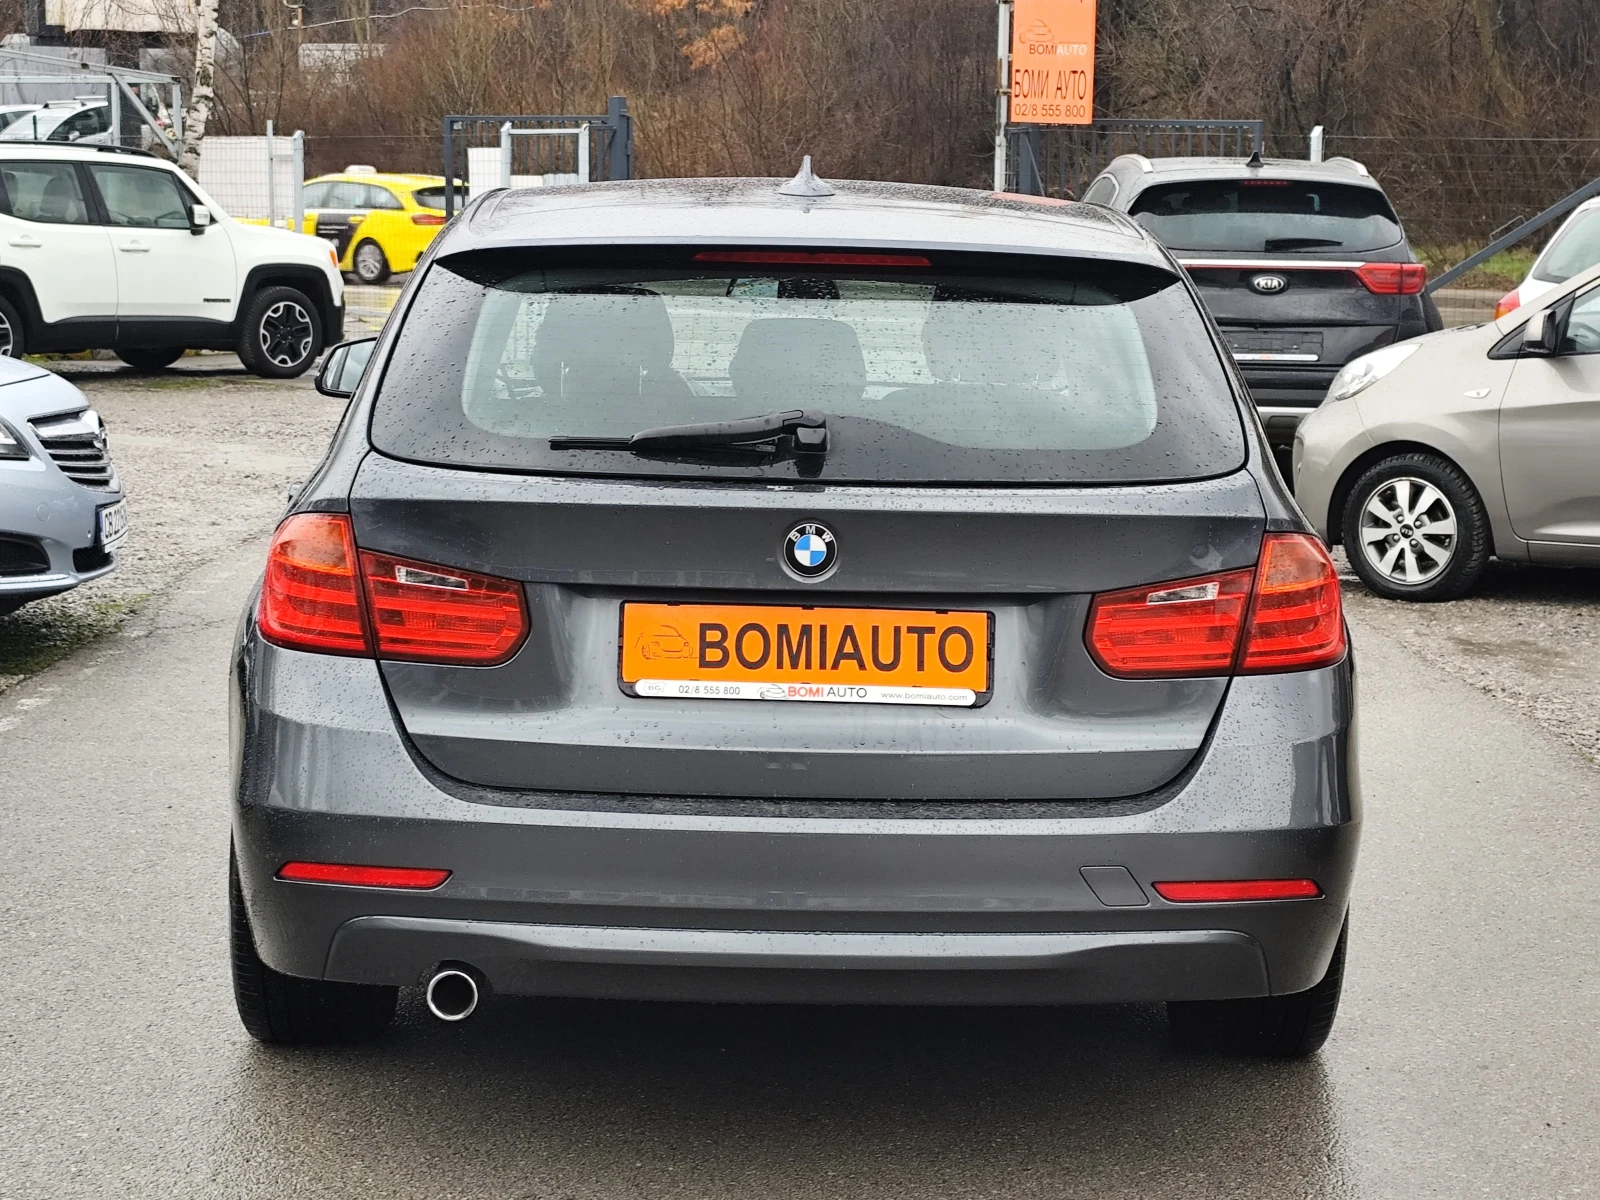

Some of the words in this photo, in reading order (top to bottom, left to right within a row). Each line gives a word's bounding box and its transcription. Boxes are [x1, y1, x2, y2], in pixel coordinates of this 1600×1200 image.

[1014, 69, 1049, 99] БОМИ
[1055, 70, 1087, 100] АУТО
[1014, 103, 1038, 117] 02/8
[1041, 104, 1062, 117] 555
[1065, 104, 1086, 118] 800
[789, 525, 834, 543] BMW
[699, 622, 974, 673] BOMIAUTO
[678, 685, 701, 695] 02/8
[703, 685, 721, 695] 555
[723, 686, 741, 696] 800
[787, 686, 824, 698] BOMI
[826, 686, 868, 699] AUTO
[880, 691, 968, 701] www.bomiauto.com
